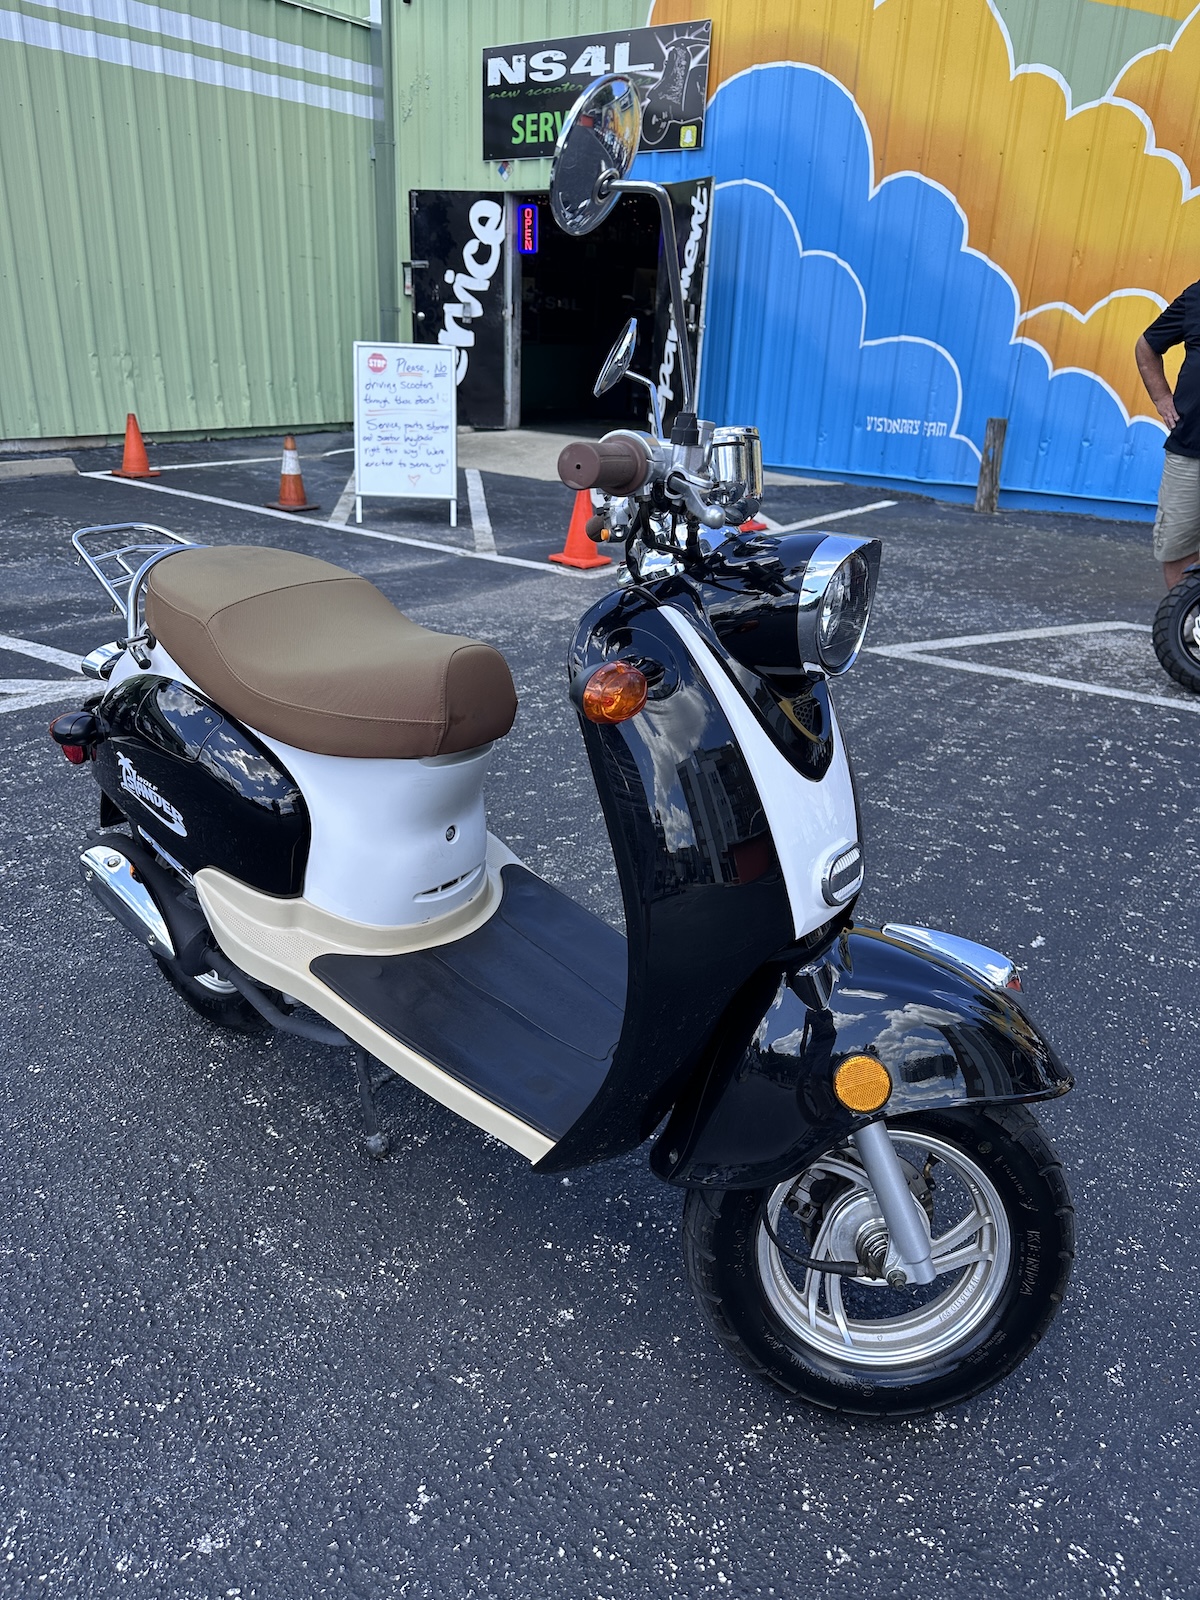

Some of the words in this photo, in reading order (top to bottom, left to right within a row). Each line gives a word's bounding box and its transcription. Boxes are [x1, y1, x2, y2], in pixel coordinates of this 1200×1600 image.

[487, 42, 655, 87] NS4L
[488, 89, 521, 99] new
[524, 208, 533, 251] OPEN
[368, 358, 387, 368] STOP
[365, 379, 397, 394] driving
[866, 416, 921, 435] VISIONARY
[922, 421, 948, 437] FAM
[364, 446, 381, 457] right
[1019, 1230, 1041, 1296] KENDA
